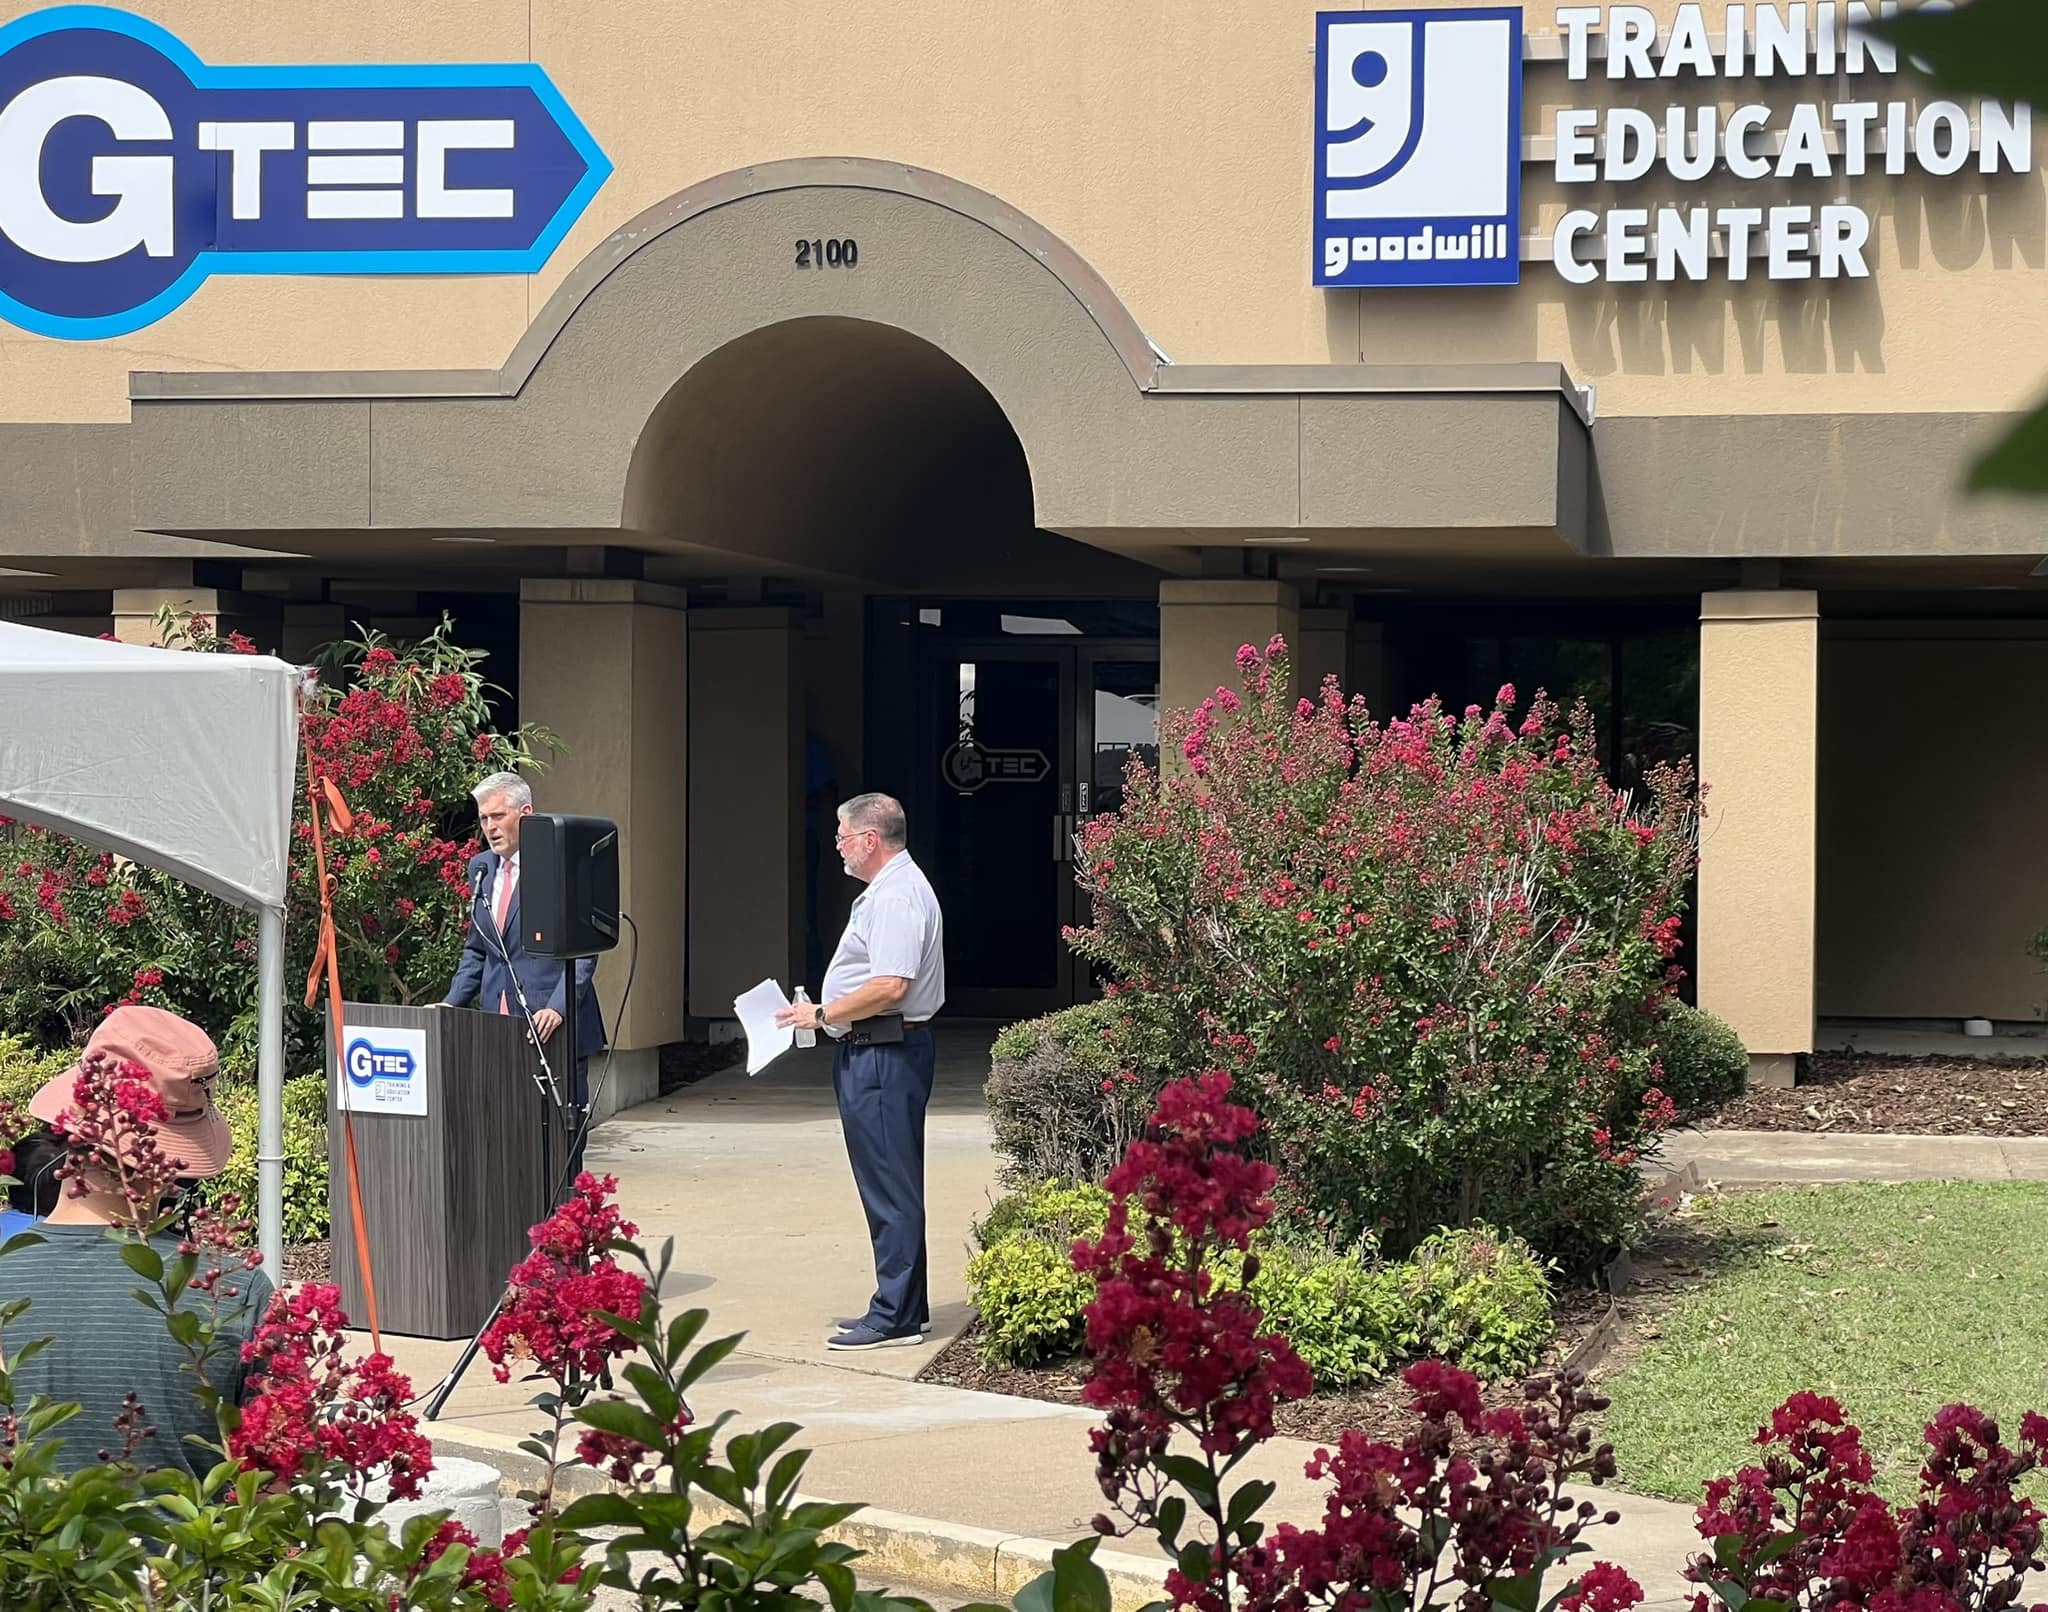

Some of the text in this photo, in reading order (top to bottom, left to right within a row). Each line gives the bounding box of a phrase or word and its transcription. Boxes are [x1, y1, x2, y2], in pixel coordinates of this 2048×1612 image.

[1556, 1, 1956, 80] TRAININ
[1554, 101, 2032, 183] EDUCATION
[795, 239, 858, 269] 2100
[1324, 224, 1507, 277] goodwill
[1553, 204, 1871, 284] CENTER
